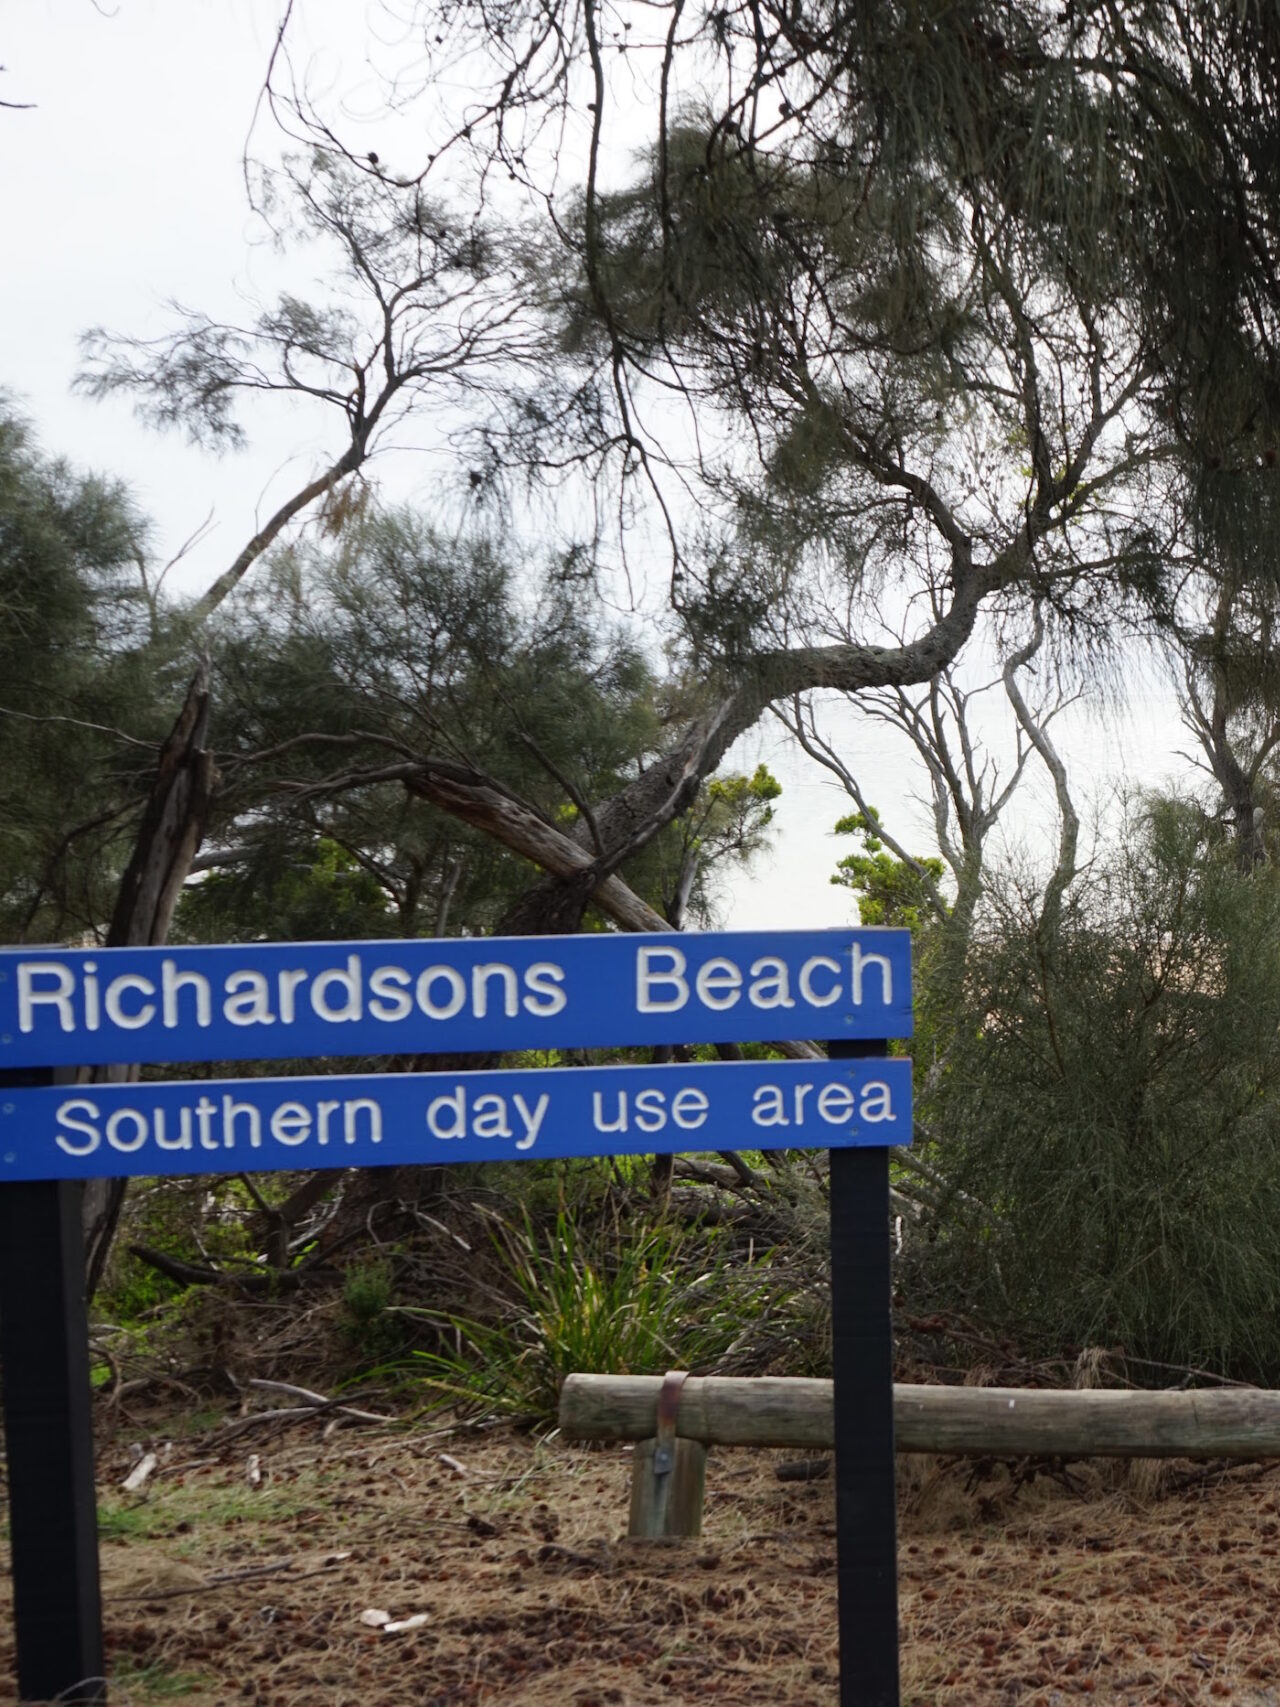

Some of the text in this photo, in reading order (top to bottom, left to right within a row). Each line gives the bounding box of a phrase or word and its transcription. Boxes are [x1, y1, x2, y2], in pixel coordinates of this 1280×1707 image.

[17, 942, 893, 1033] Richardsons Beach
[56, 1081, 897, 1156] Southern day use area
